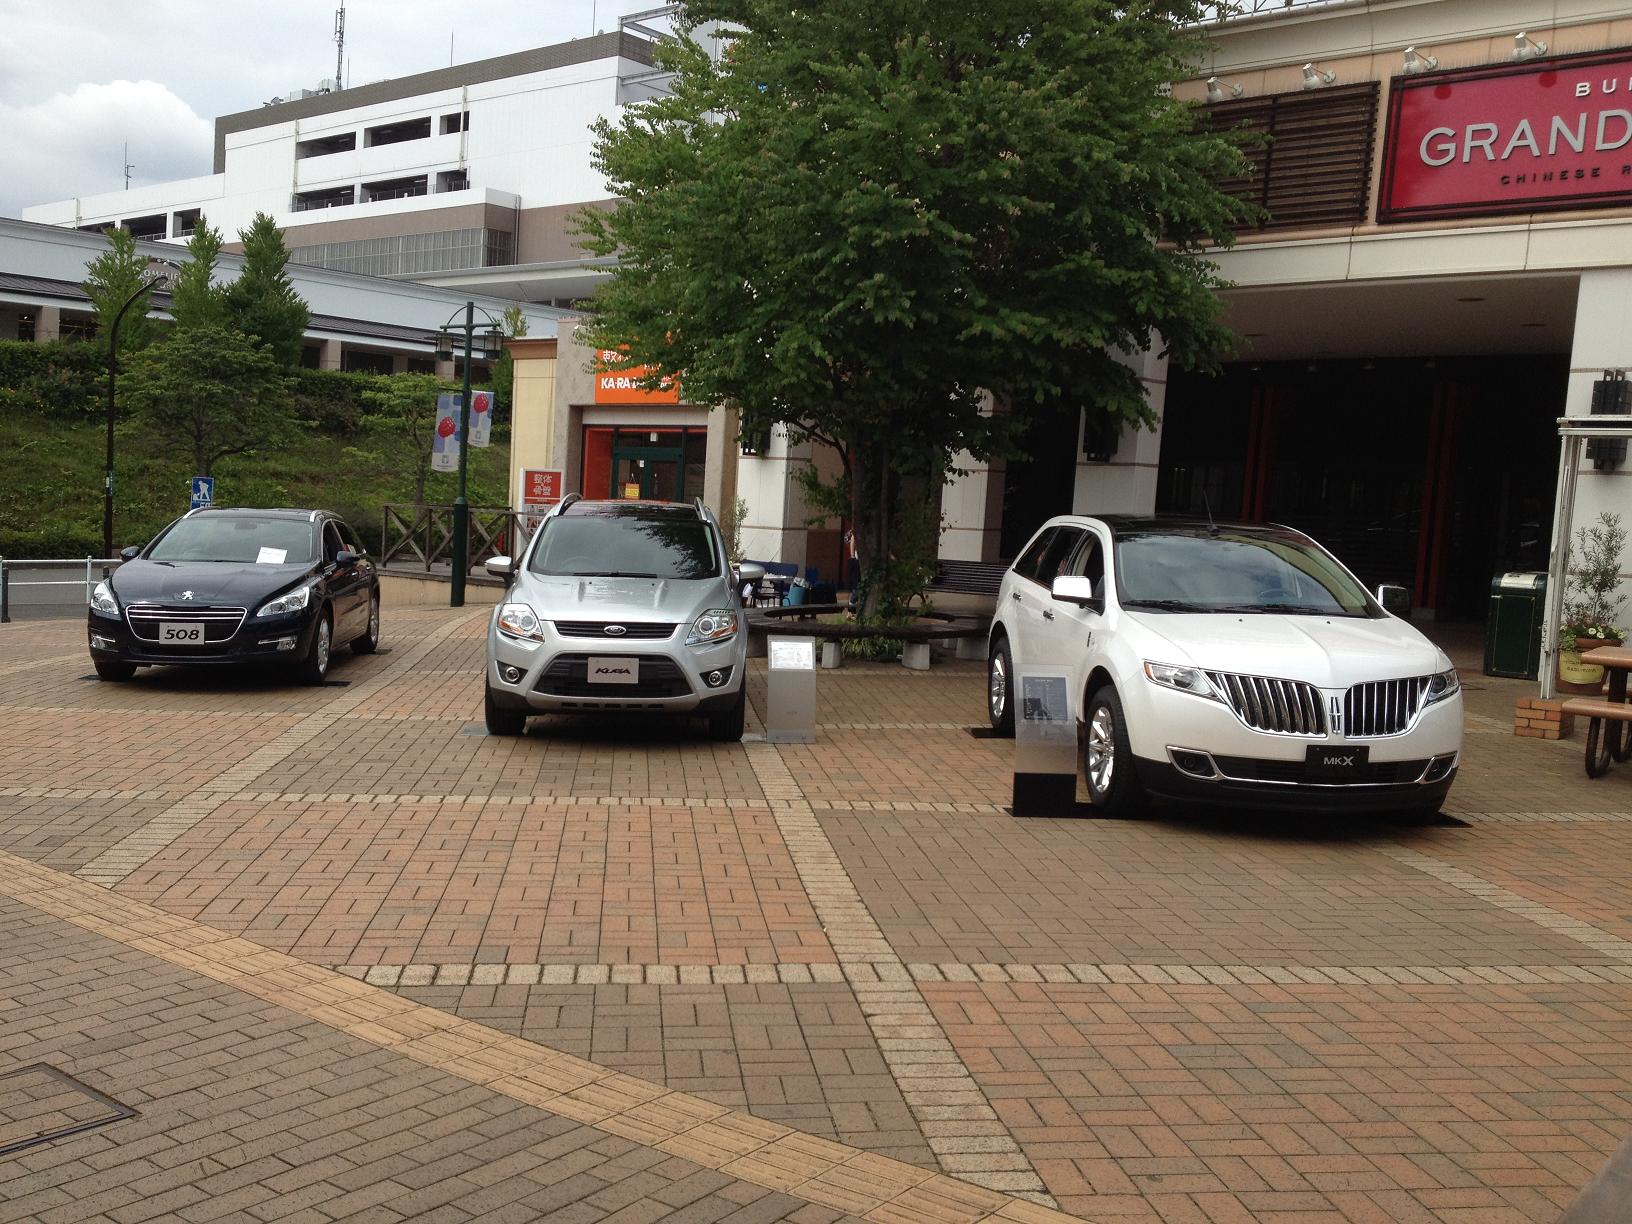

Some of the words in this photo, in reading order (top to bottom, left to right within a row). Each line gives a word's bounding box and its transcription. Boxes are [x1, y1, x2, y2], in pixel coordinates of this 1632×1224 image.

[1575, 76, 1632, 98] BU
[1419, 108, 1632, 167] GRAND
[1501, 167, 1601, 185] CHINESE
[164, 629, 200, 640] 508
[1323, 755, 1354, 766] MKX
